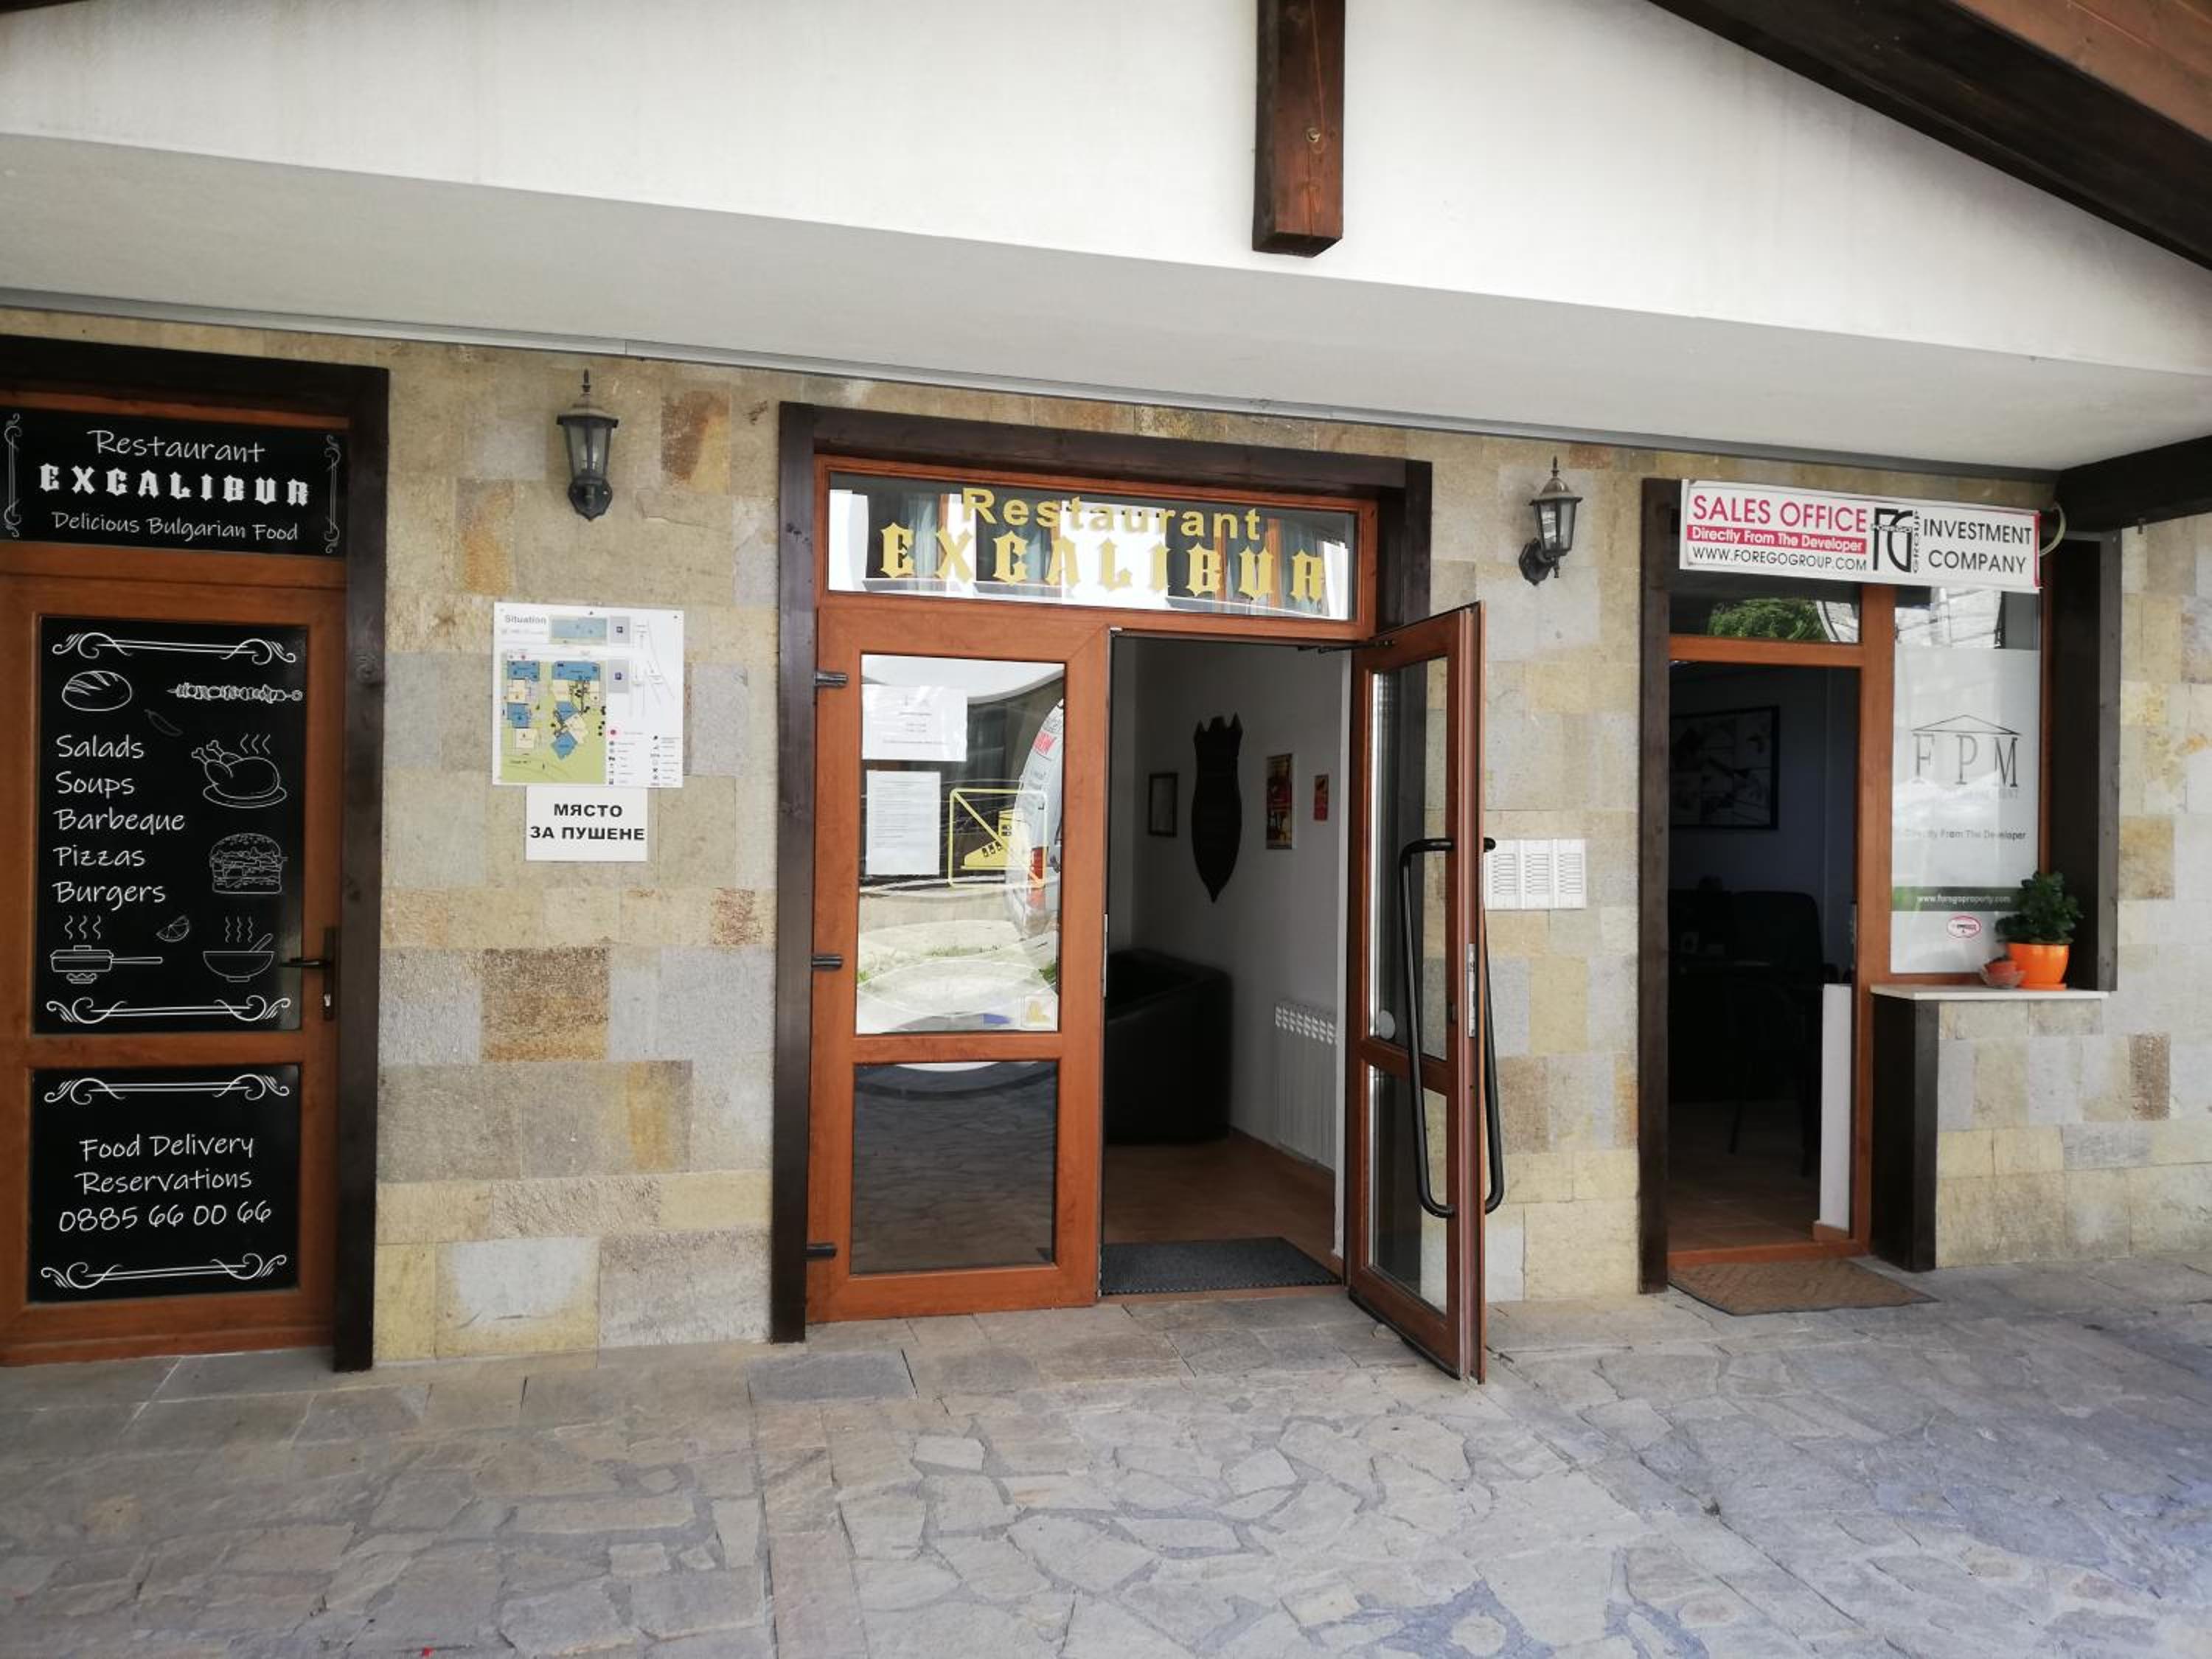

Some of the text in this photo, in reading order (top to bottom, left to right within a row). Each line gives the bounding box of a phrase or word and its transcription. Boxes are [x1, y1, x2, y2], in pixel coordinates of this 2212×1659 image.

[86, 430, 265, 463] Restaurant
[38, 462, 309, 507] EXCALIBUR
[52, 511, 298, 542] Delicious Bulgarian Food
[962, 487, 1262, 541] Restaurant
[1693, 494, 1867, 533] SALES OFFICE
[1692, 526, 1863, 552] Directly From The Developer
[1924, 518, 2032, 545] INVESTMENT
[879, 522, 1324, 602] EXCALIBUR
[1693, 546, 1867, 571] WWW.FOREGOGROUP.COM
[1928, 549, 2027, 574] COMPANY
[55, 734, 145, 759] Salads
[55, 771, 135, 799] Soups
[53, 806, 185, 835] Barbeque
[554, 803, 623, 818] МЯСТО
[530, 826, 645, 841] ЗА ПУШЕНЕ
[1983, 830, 2026, 841] Deeloper
[53, 844, 146, 867] Pizzas
[52, 880, 166, 911] Burgers
[79, 1134, 254, 1161] Food Delivery
[74, 1168, 253, 1195] Reservations
[59, 1200, 272, 1233] 0885 66 00 66
